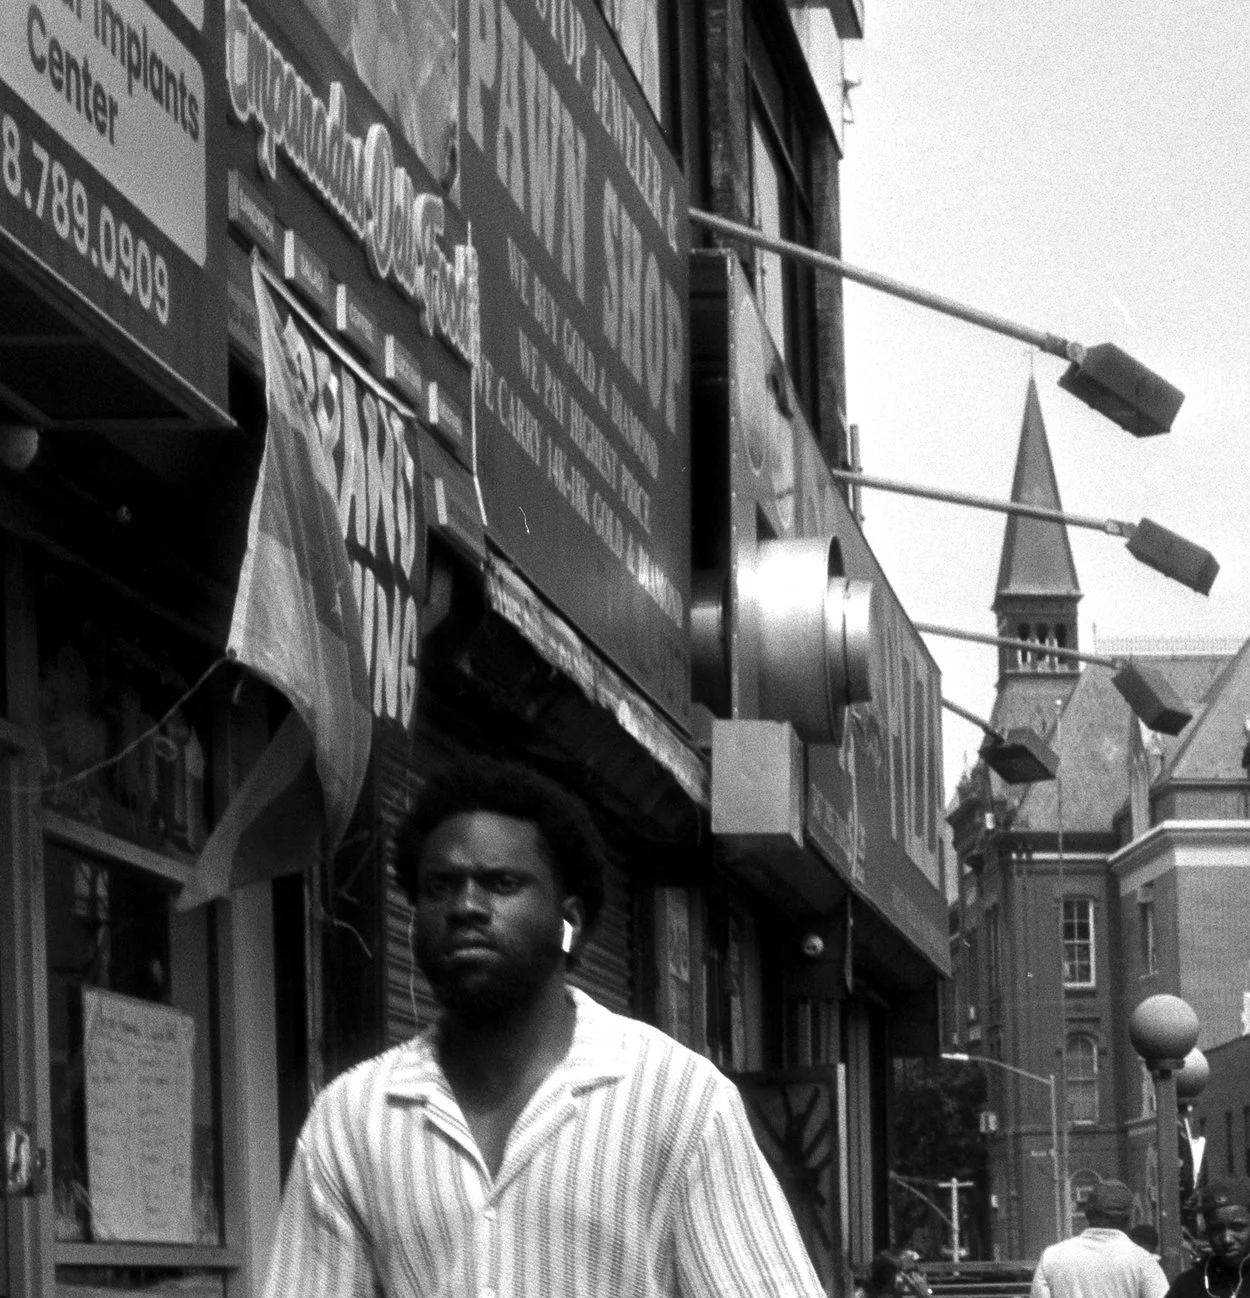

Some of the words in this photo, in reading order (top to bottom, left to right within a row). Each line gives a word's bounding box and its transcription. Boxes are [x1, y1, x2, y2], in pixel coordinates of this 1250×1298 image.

[27, 4, 118, 146] Center
[592, 45, 663, 230] JEWELER
[466, 0, 587, 306] PAWN
[603, 177, 684, 434] SHOP
[507, 236, 529, 306] WE
[534, 272, 558, 346] BUY
[563, 317, 595, 394] GOLD
[500, 376, 540, 467] CARRY
[519, 327, 539, 396] WE
[544, 361, 565, 426] PAY
[570, 396, 618, 491] HIGHEST
